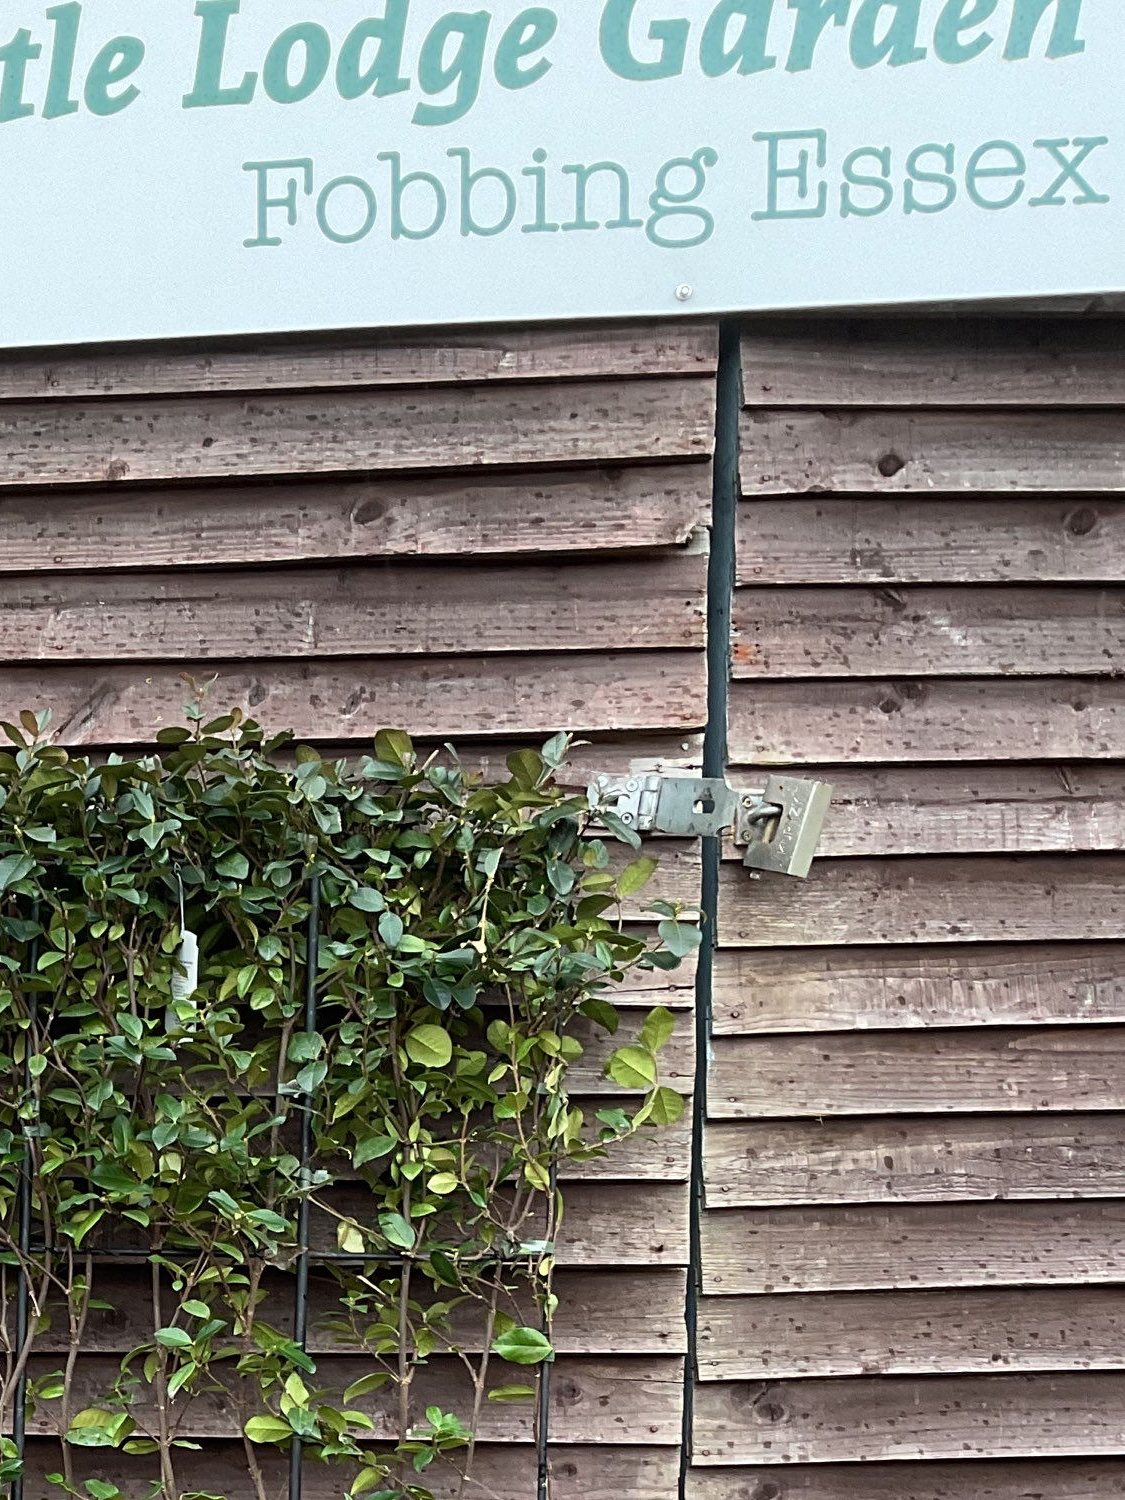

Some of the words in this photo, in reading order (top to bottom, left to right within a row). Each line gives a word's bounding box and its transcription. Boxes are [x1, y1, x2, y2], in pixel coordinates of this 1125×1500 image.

[181, 0, 559, 126] Lodge
[598, 0, 1088, 82] Garden
[242, 145, 721, 249] Fobbing
[752, 127, 1112, 221] Essex
